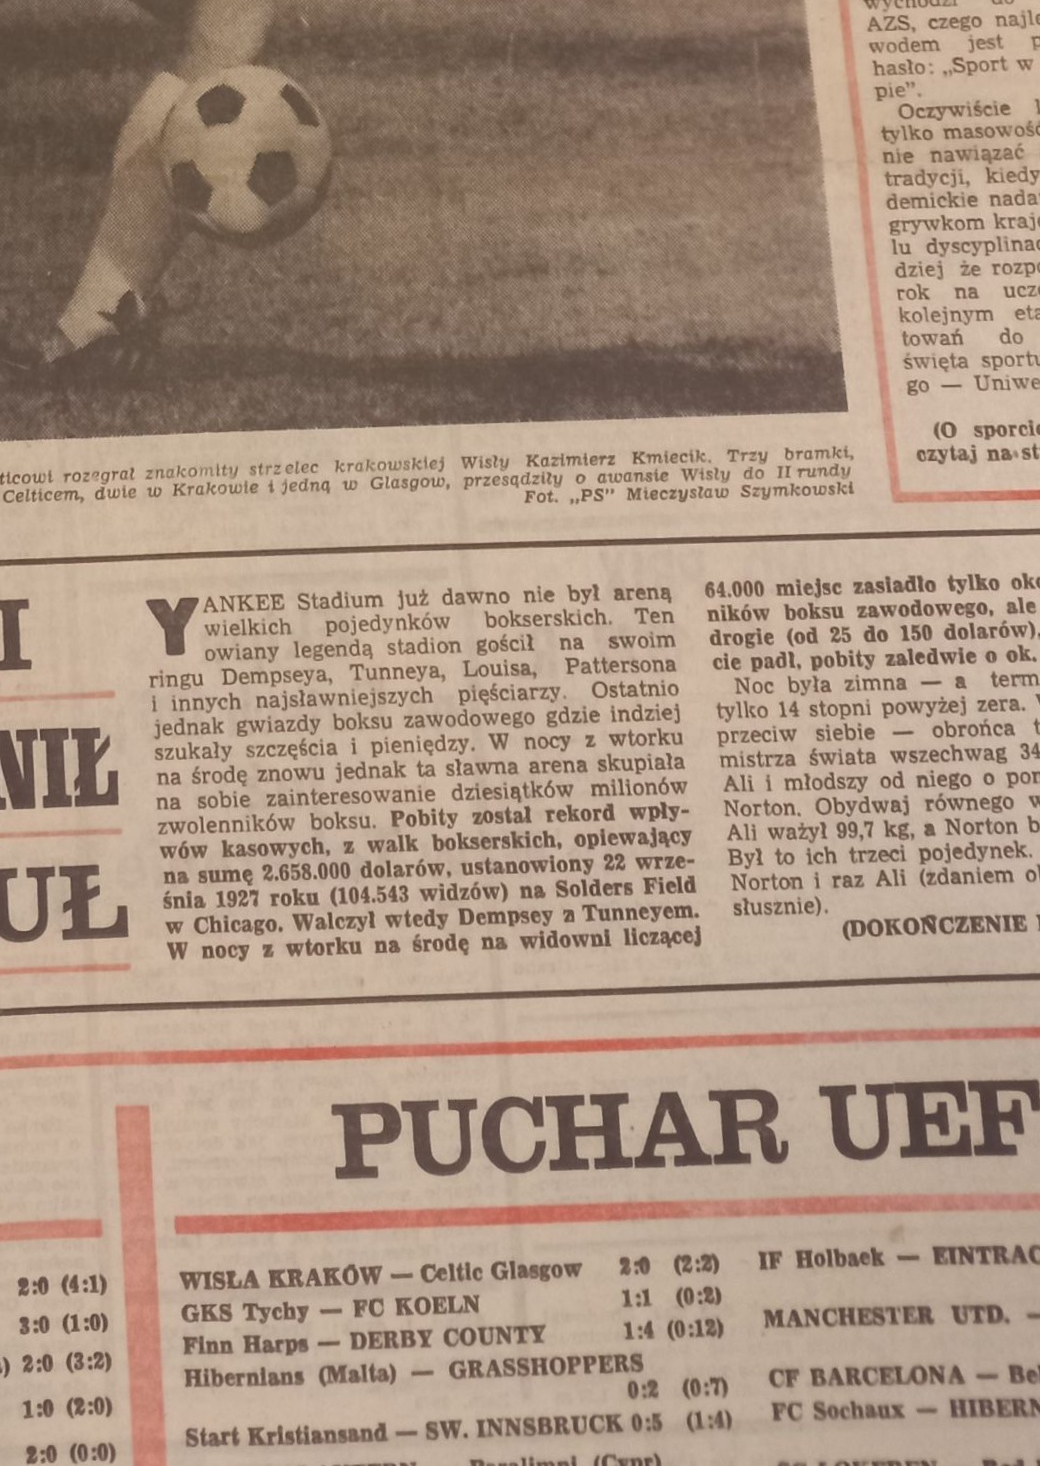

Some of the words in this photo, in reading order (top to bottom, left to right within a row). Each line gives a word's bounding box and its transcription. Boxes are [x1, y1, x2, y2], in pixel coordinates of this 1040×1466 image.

[63, 467, 134, 485] rozegrał
[145, 463, 238, 480] znakomity
[250, 461, 318, 476] strzelec
[335, 456, 444, 473] krakowskiej
[461, 455, 509, 471] Wisły
[526, 453, 615, 467] Kazimierz
[727, 449, 768, 464] Trzy
[627, 486, 729, 503] Mieczysław
[741, 481, 854, 500] Szymkowski
[297, 591, 383, 611] Stadium
[398, 589, 429, 610] już
[442, 588, 510, 605] dawno
[523, 586, 555, 603] nie
[567, 584, 600, 605] był
[614, 587, 672, 603] areną
[164, 871, 189, 884] na
[198, 869, 253, 886] sumę
[262, 862, 350, 881] 2.658.000
[461, 855, 593, 876] ustanowiony
[604, 853, 625, 871] 22
[843, 915, 1027, 941] (DOKOŃCZENIE
[331, 1089, 789, 1179] PUCHAR
[18, 1277, 49, 1296] 2:0
[61, 1274, 107, 1296] (4:1)
[179, 1270, 260, 1290] WISŁA
[268, 1264, 382, 1288] KRAKÓW
[420, 1262, 482, 1283] Celtic
[491, 1261, 582, 1282] Glasgow
[620, 1256, 650, 1275] 2:0
[674, 1254, 719, 1276] (2:2)
[19, 1316, 50, 1335] 3:0
[63, 1313, 108, 1334] (1:0)
[764, 1306, 934, 1328] MANCHESTER
